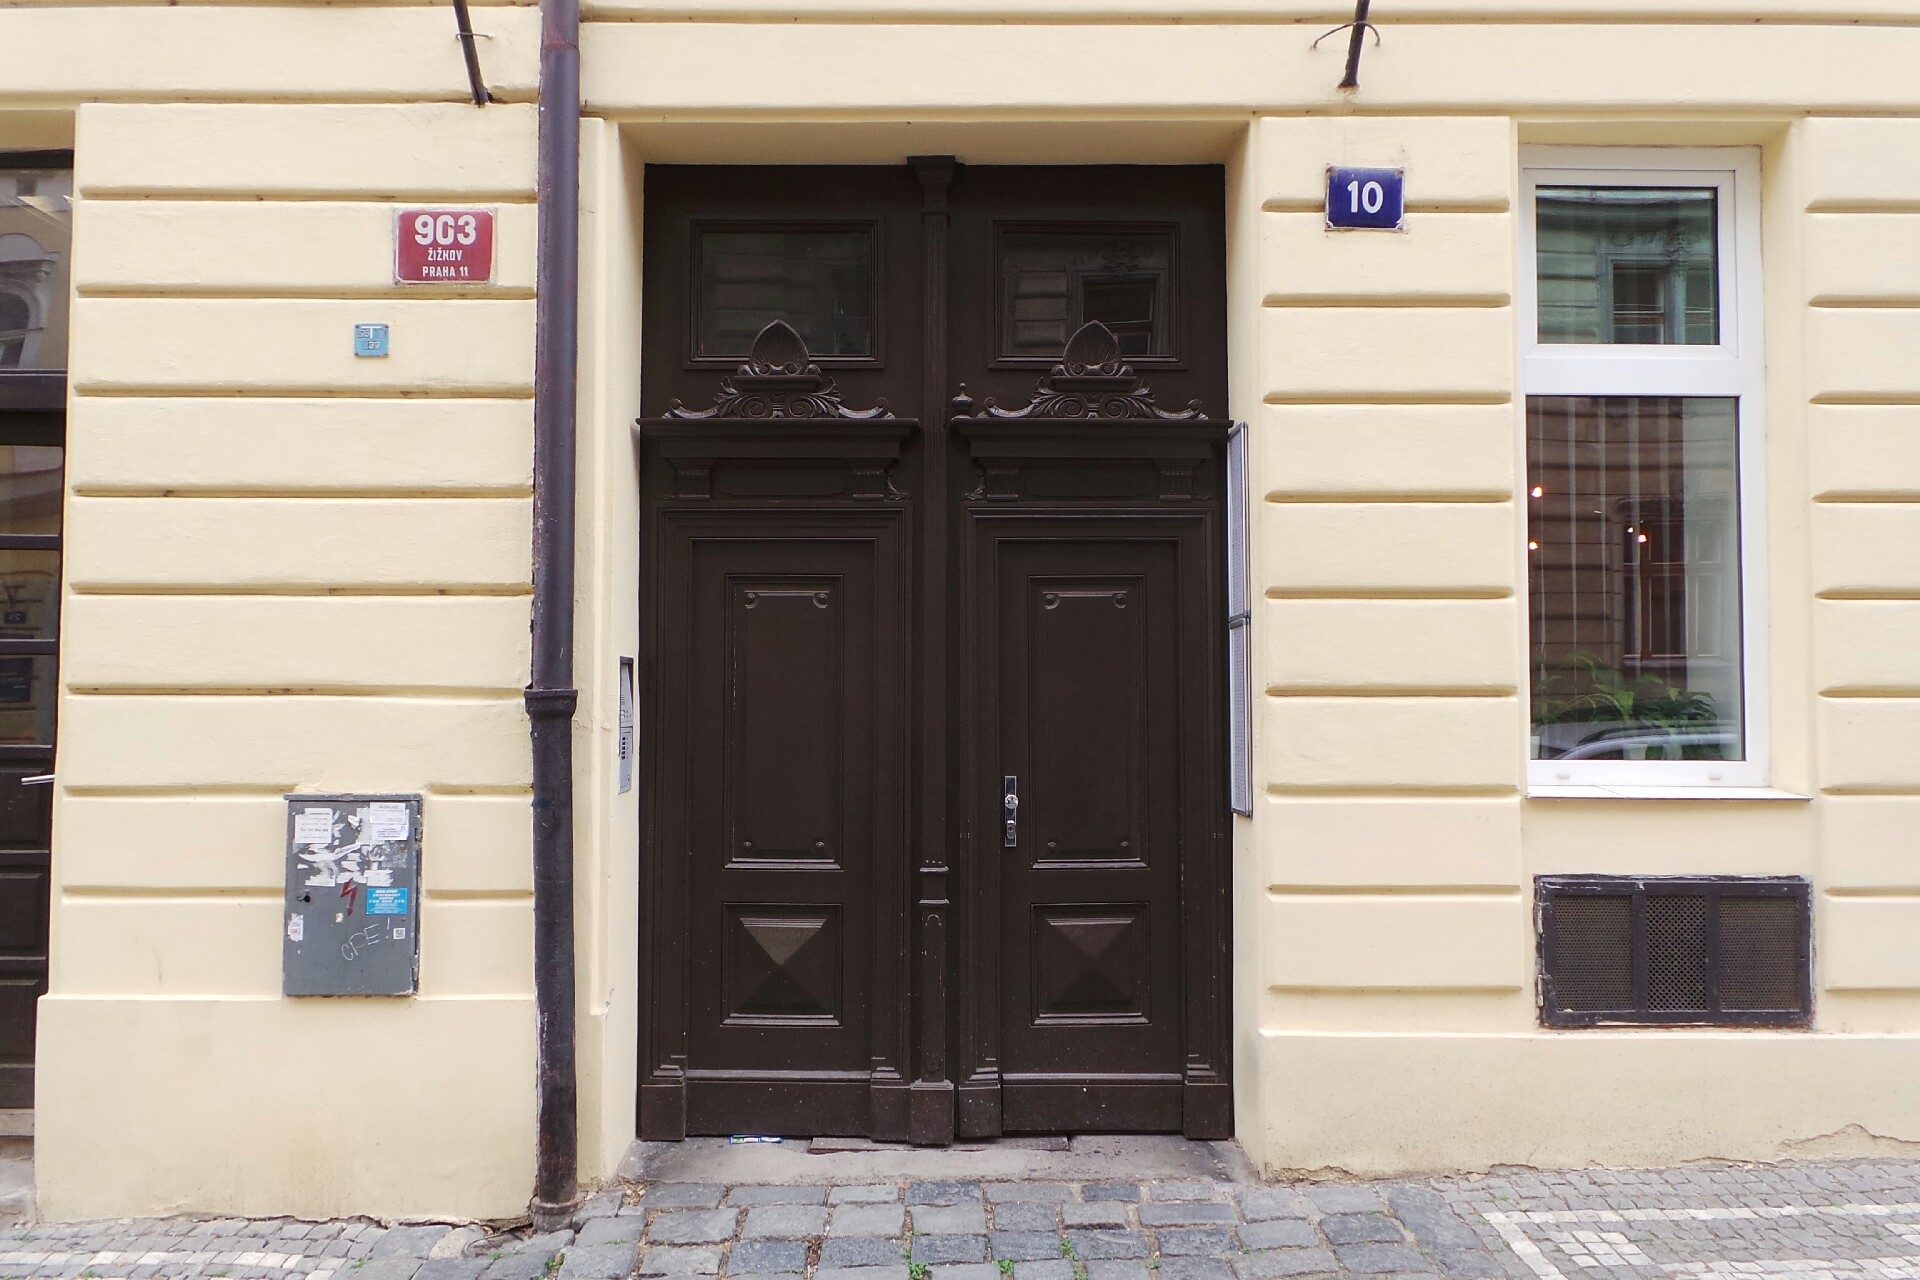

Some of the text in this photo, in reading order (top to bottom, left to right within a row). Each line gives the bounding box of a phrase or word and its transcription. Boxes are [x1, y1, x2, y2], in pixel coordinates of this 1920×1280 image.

[1347, 180, 1383, 213] 10
[414, 214, 477, 245] 903
[427, 247, 463, 261] ŽIŽKOV
[422, 265, 468, 277] PRAHA 11
